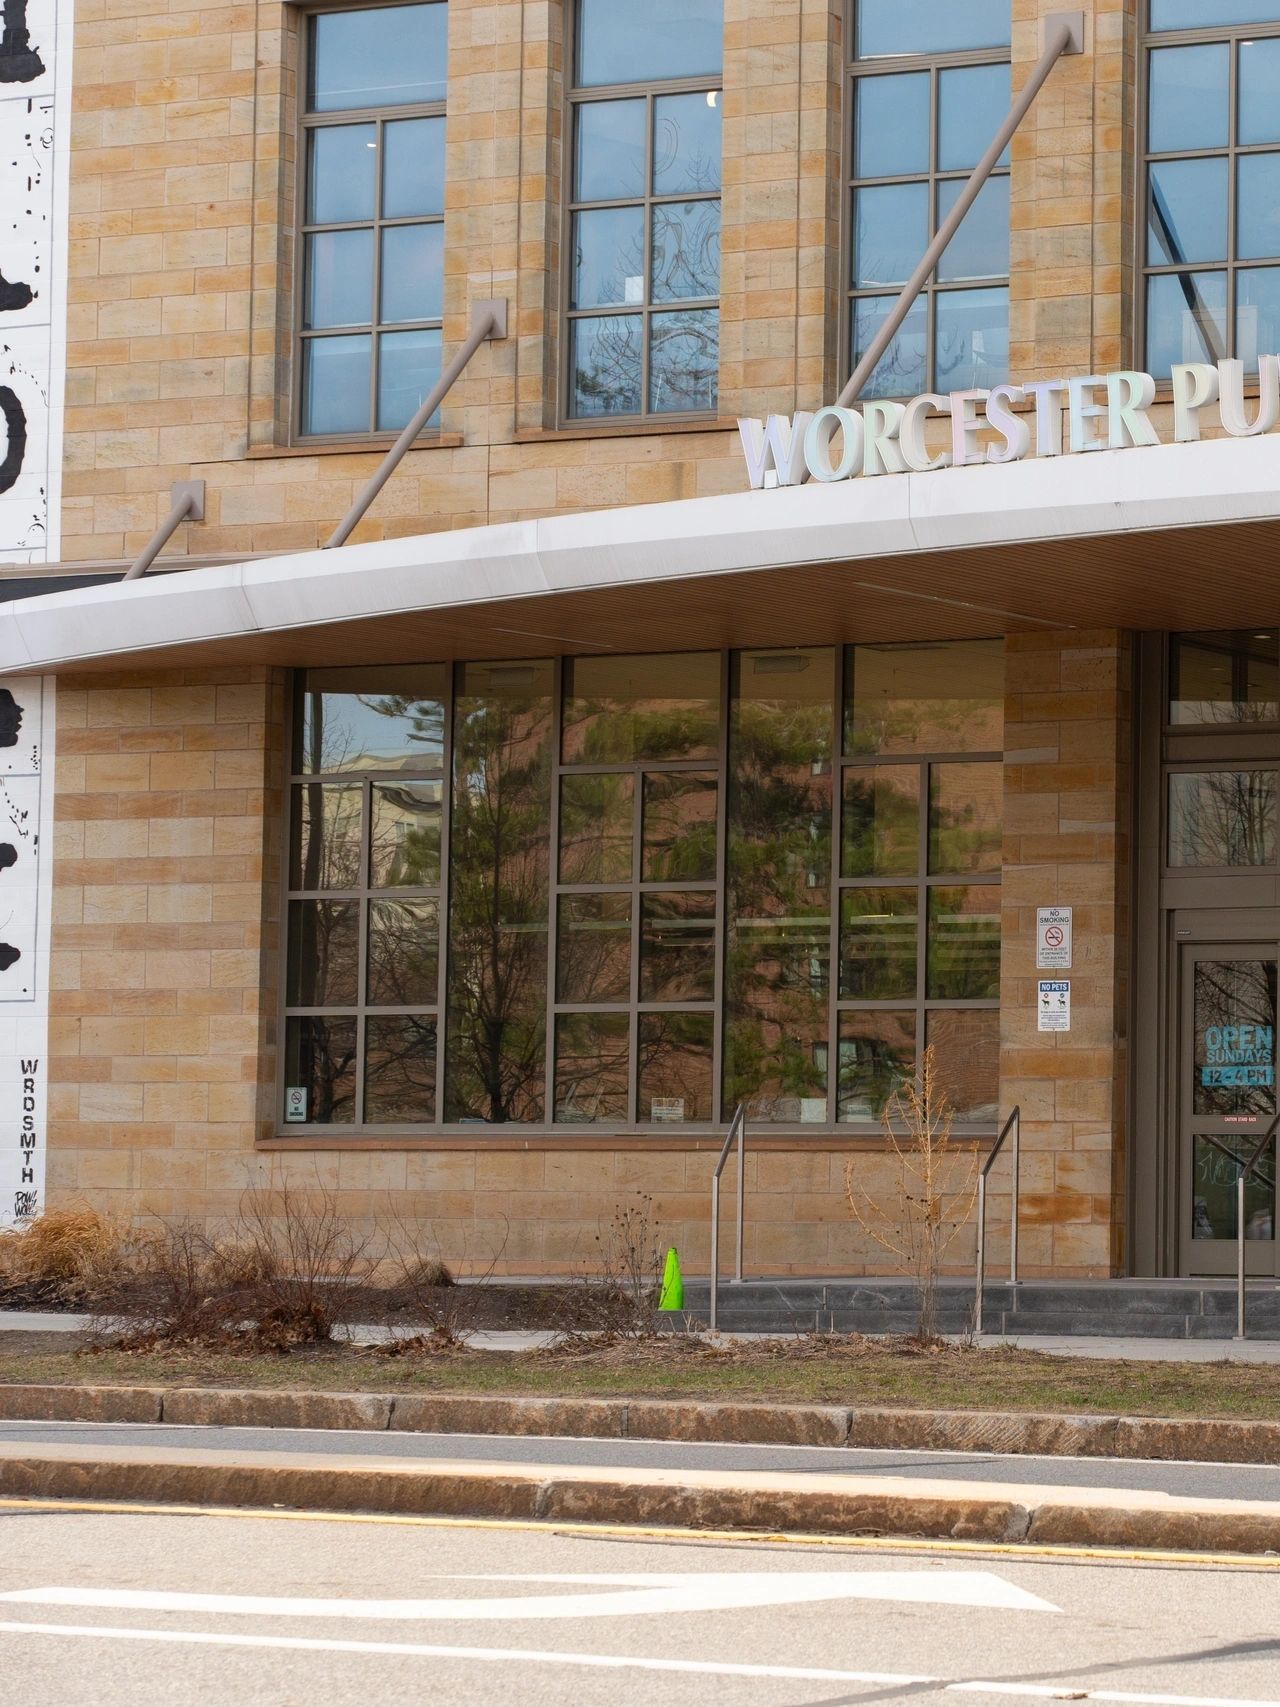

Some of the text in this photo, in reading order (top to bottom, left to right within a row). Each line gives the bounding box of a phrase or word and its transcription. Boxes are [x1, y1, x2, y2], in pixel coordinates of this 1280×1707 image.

[737, 371, 1162, 489] WORCESTER
[1052, 983, 1067, 991] PETS
[1205, 1025, 1272, 1050] OPEN
[1206, 1048, 1271, 1063] SUNDAYS
[1209, 1069, 1222, 1083] 12
[1247, 1069, 1266, 1083] PM
[20, 1059, 38, 1183] WRDSMTH
